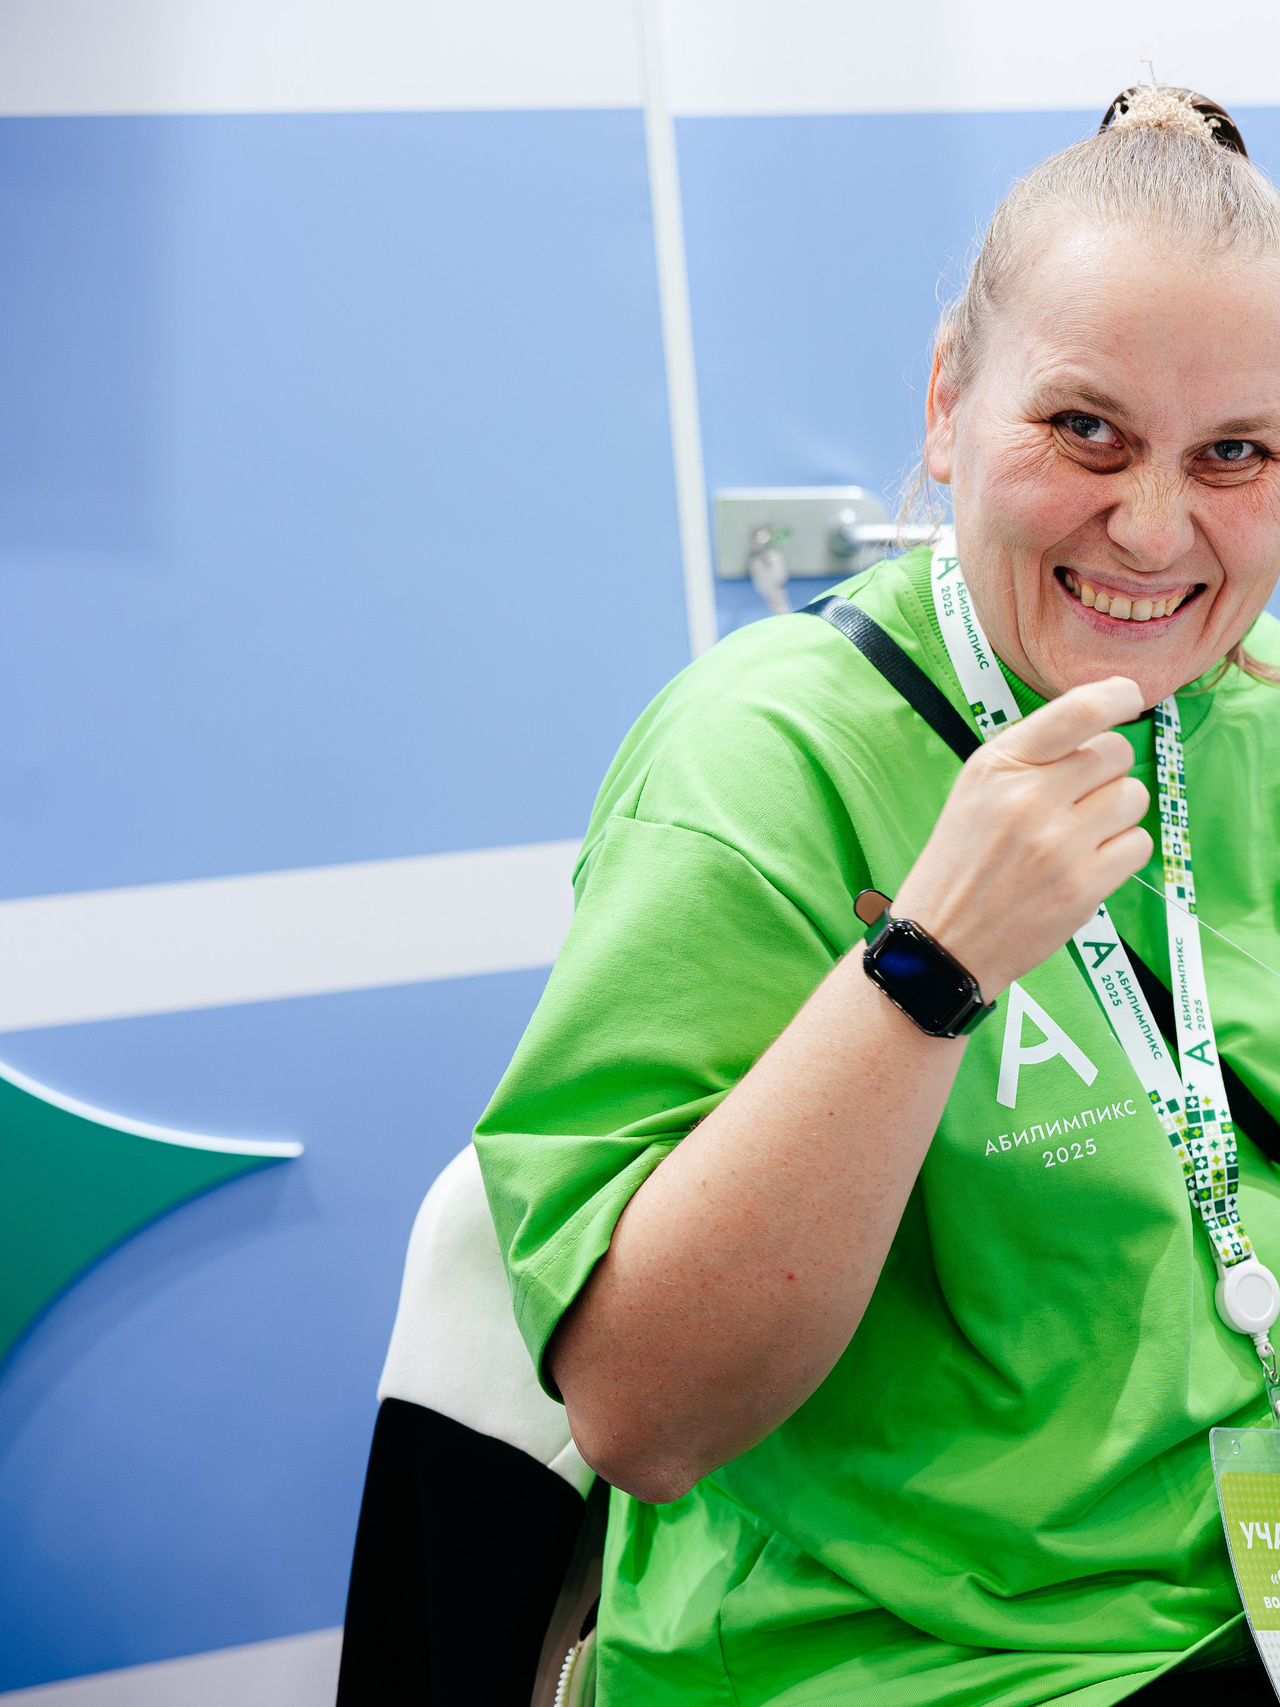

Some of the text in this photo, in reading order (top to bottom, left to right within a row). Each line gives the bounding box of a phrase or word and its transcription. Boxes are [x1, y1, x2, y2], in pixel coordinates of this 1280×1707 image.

[941, 585, 954, 617] 2025
[956, 581, 990, 670] АБИЛИМПИКС
[1101, 974, 1122, 1007] 2025
[1176, 937, 1193, 1030] АБИЛИМПИКС
[1115, 970, 1162, 1060] АБИЛИМПИКС
[1197, 999, 1206, 1030] 2025
[984, 1099, 1137, 1156] АБИЛИМПИКС
[1042, 1138, 1097, 1168] 2025
